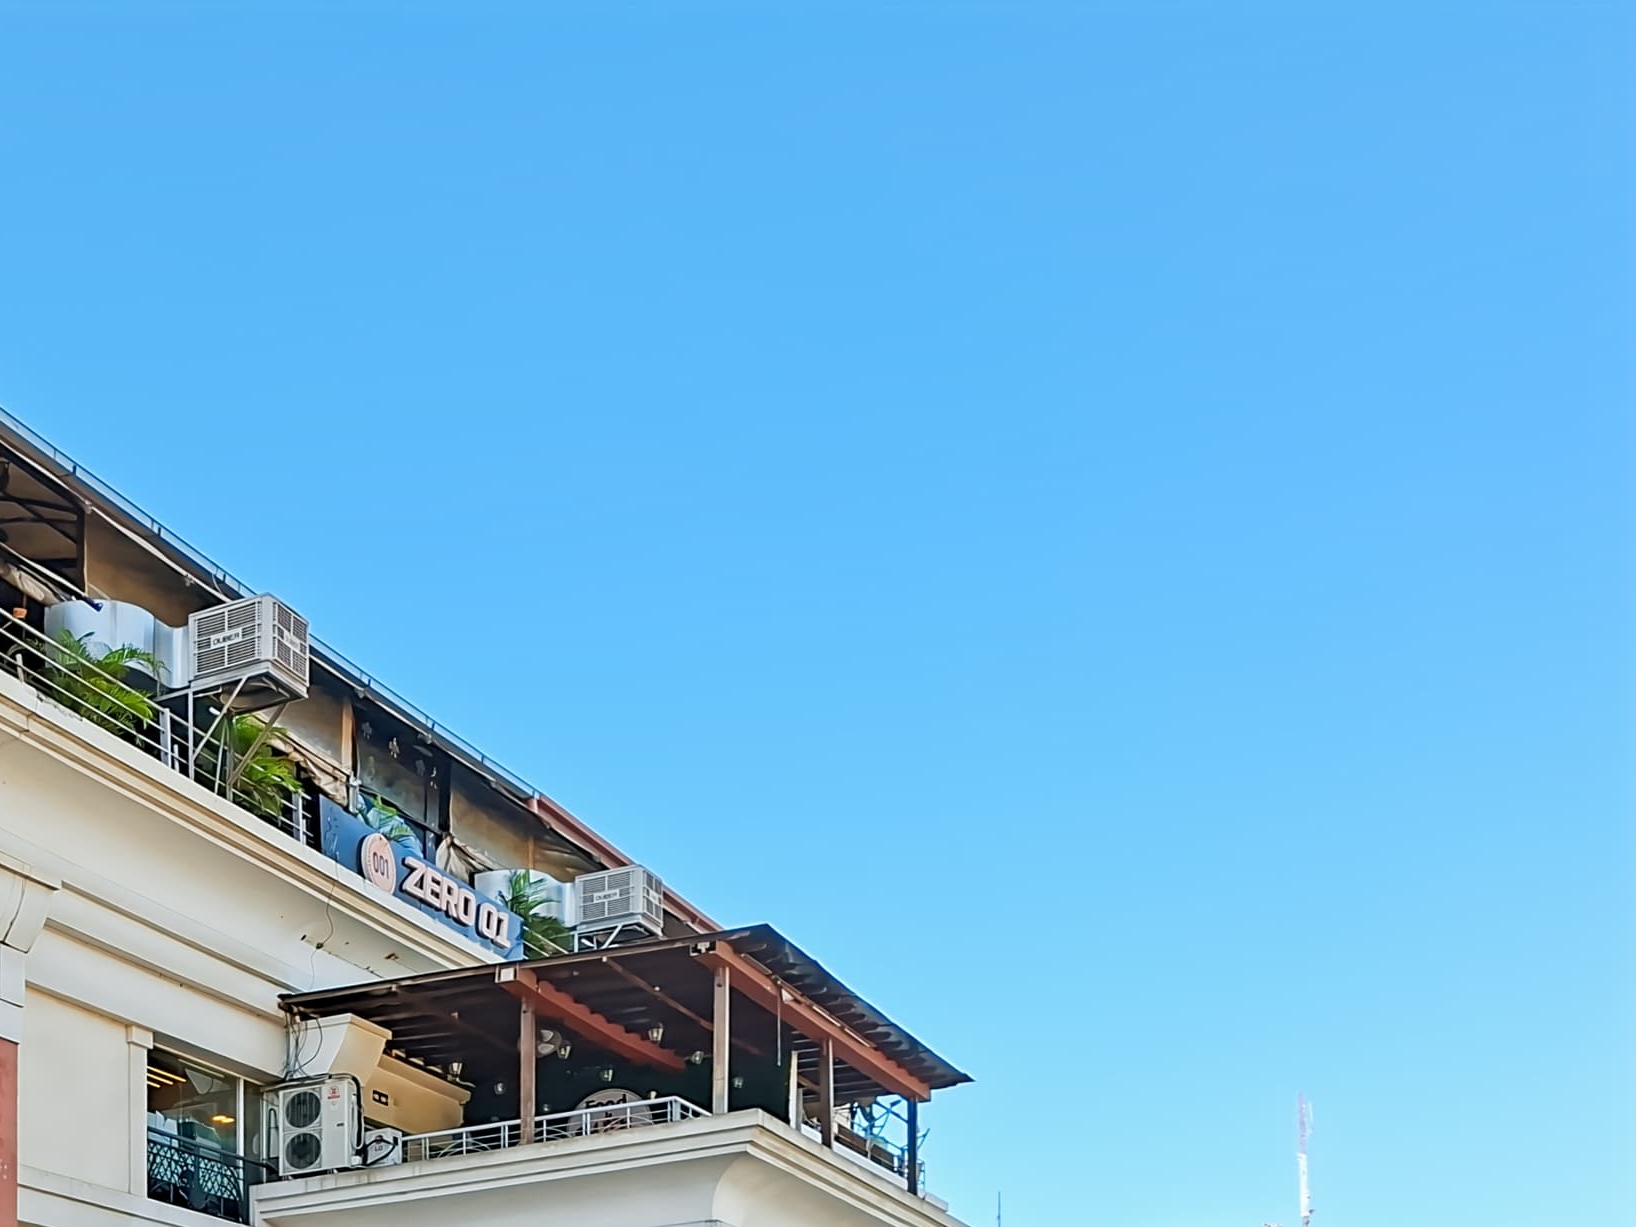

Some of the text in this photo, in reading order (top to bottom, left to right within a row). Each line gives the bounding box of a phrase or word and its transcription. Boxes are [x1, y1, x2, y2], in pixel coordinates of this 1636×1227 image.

[372, 851, 390, 880] 001
[401, 855, 512, 949] ZERO 01
